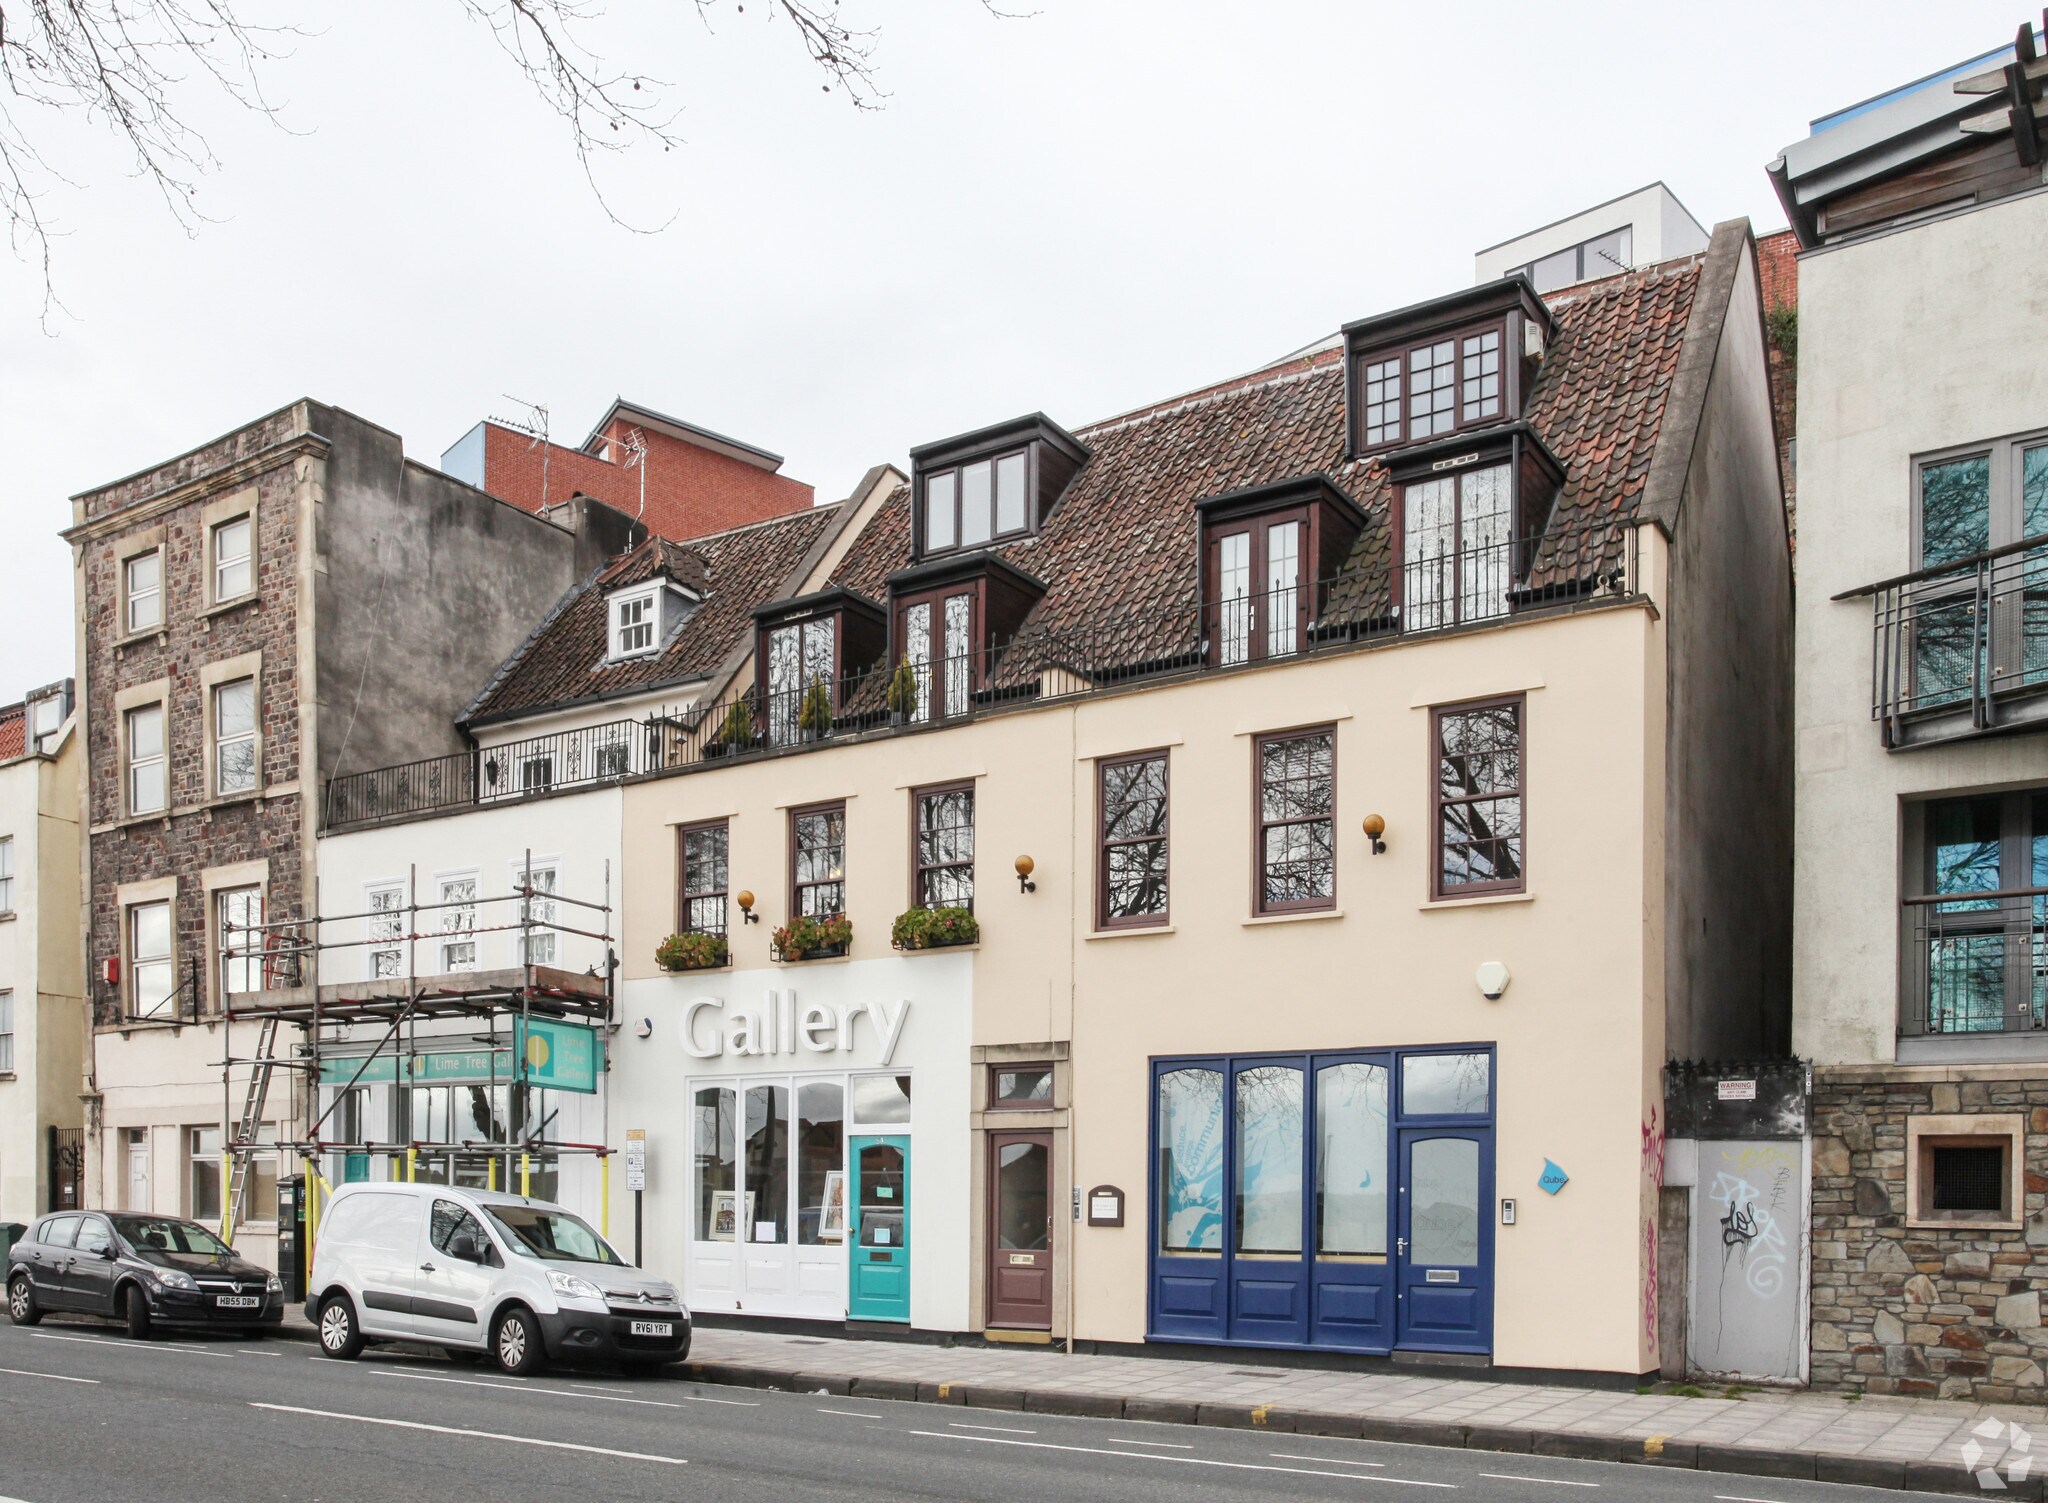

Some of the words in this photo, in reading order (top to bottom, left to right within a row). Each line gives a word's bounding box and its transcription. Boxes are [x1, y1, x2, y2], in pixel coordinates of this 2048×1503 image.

[679, 988, 910, 1066] Gallery
[563, 1035, 585, 1049] Lime
[435, 1056, 460, 1071] Lime
[464, 1055, 488, 1069] Tree
[564, 1050, 585, 1065] Tree
[557, 1065, 589, 1083] Gallery
[1543, 1176, 1564, 1184] Qube
[636, 1323, 653, 1333] RV61
[655, 1324, 667, 1334] YRT
